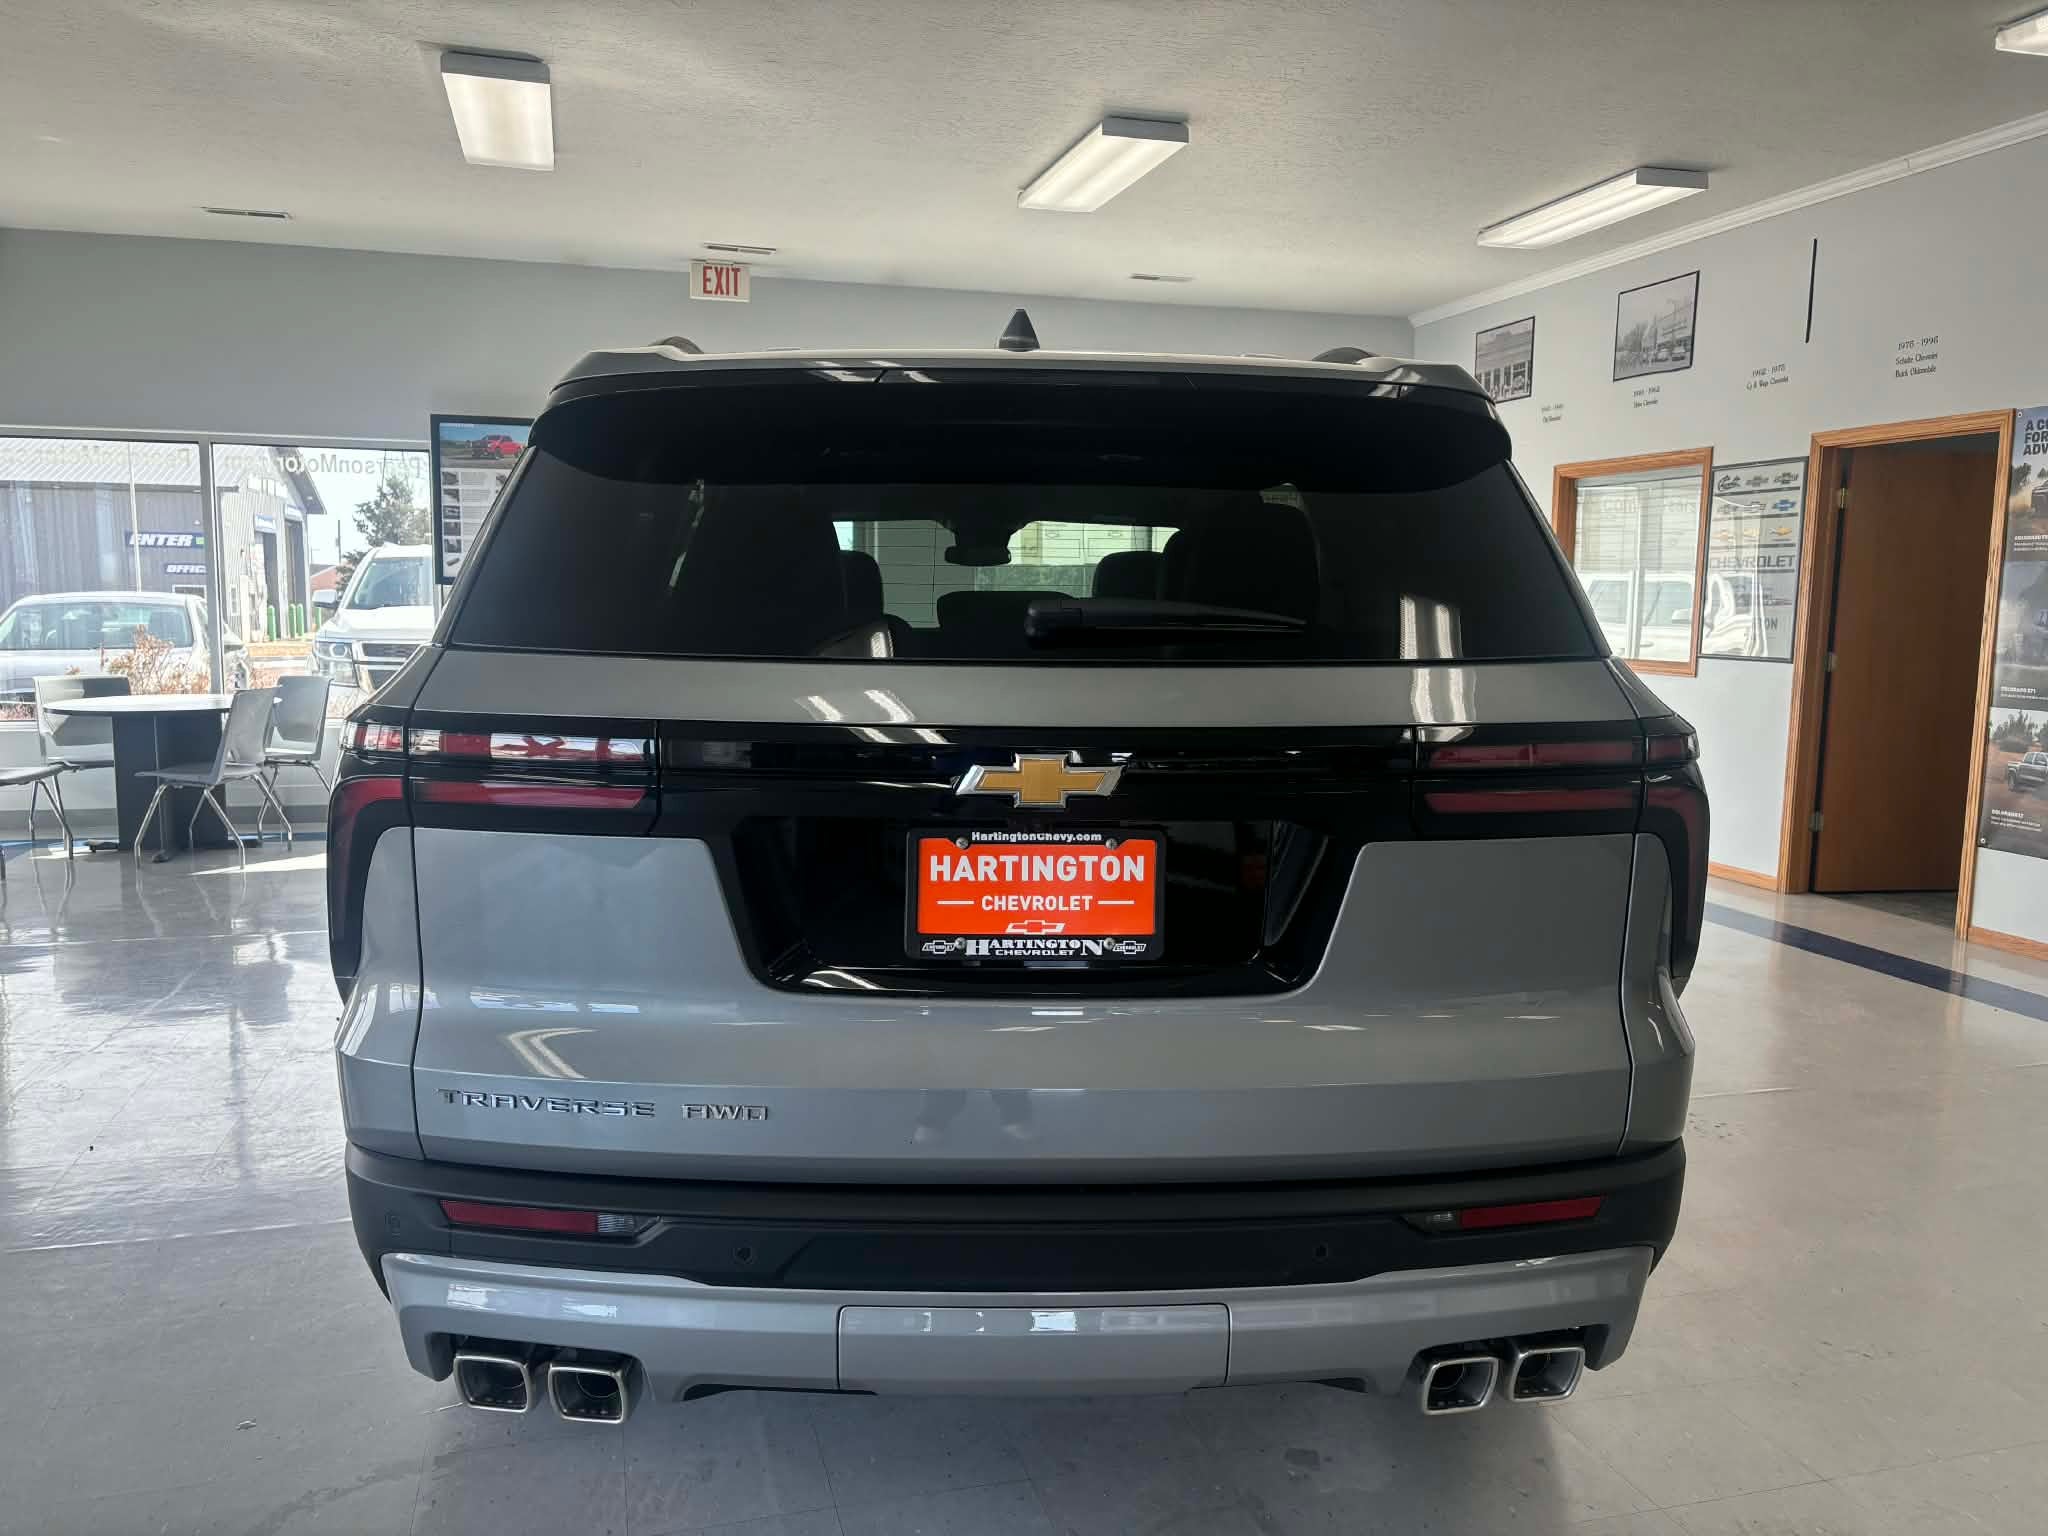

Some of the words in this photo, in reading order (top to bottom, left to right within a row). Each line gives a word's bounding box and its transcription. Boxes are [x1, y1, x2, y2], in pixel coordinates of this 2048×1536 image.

[703, 265, 741, 296] EXIT
[2025, 419, 2034, 431] A
[129, 533, 193, 547] ENTER
[971, 831, 1102, 843] HartingtonChevy.com
[929, 855, 1144, 882] HARTINGTON
[981, 896, 1093, 911] CHEVROLET
[964, 939, 1106, 956] HARTINGTON
[436, 1088, 656, 1118] TRAVERSE
[680, 1103, 769, 1121] AWD
